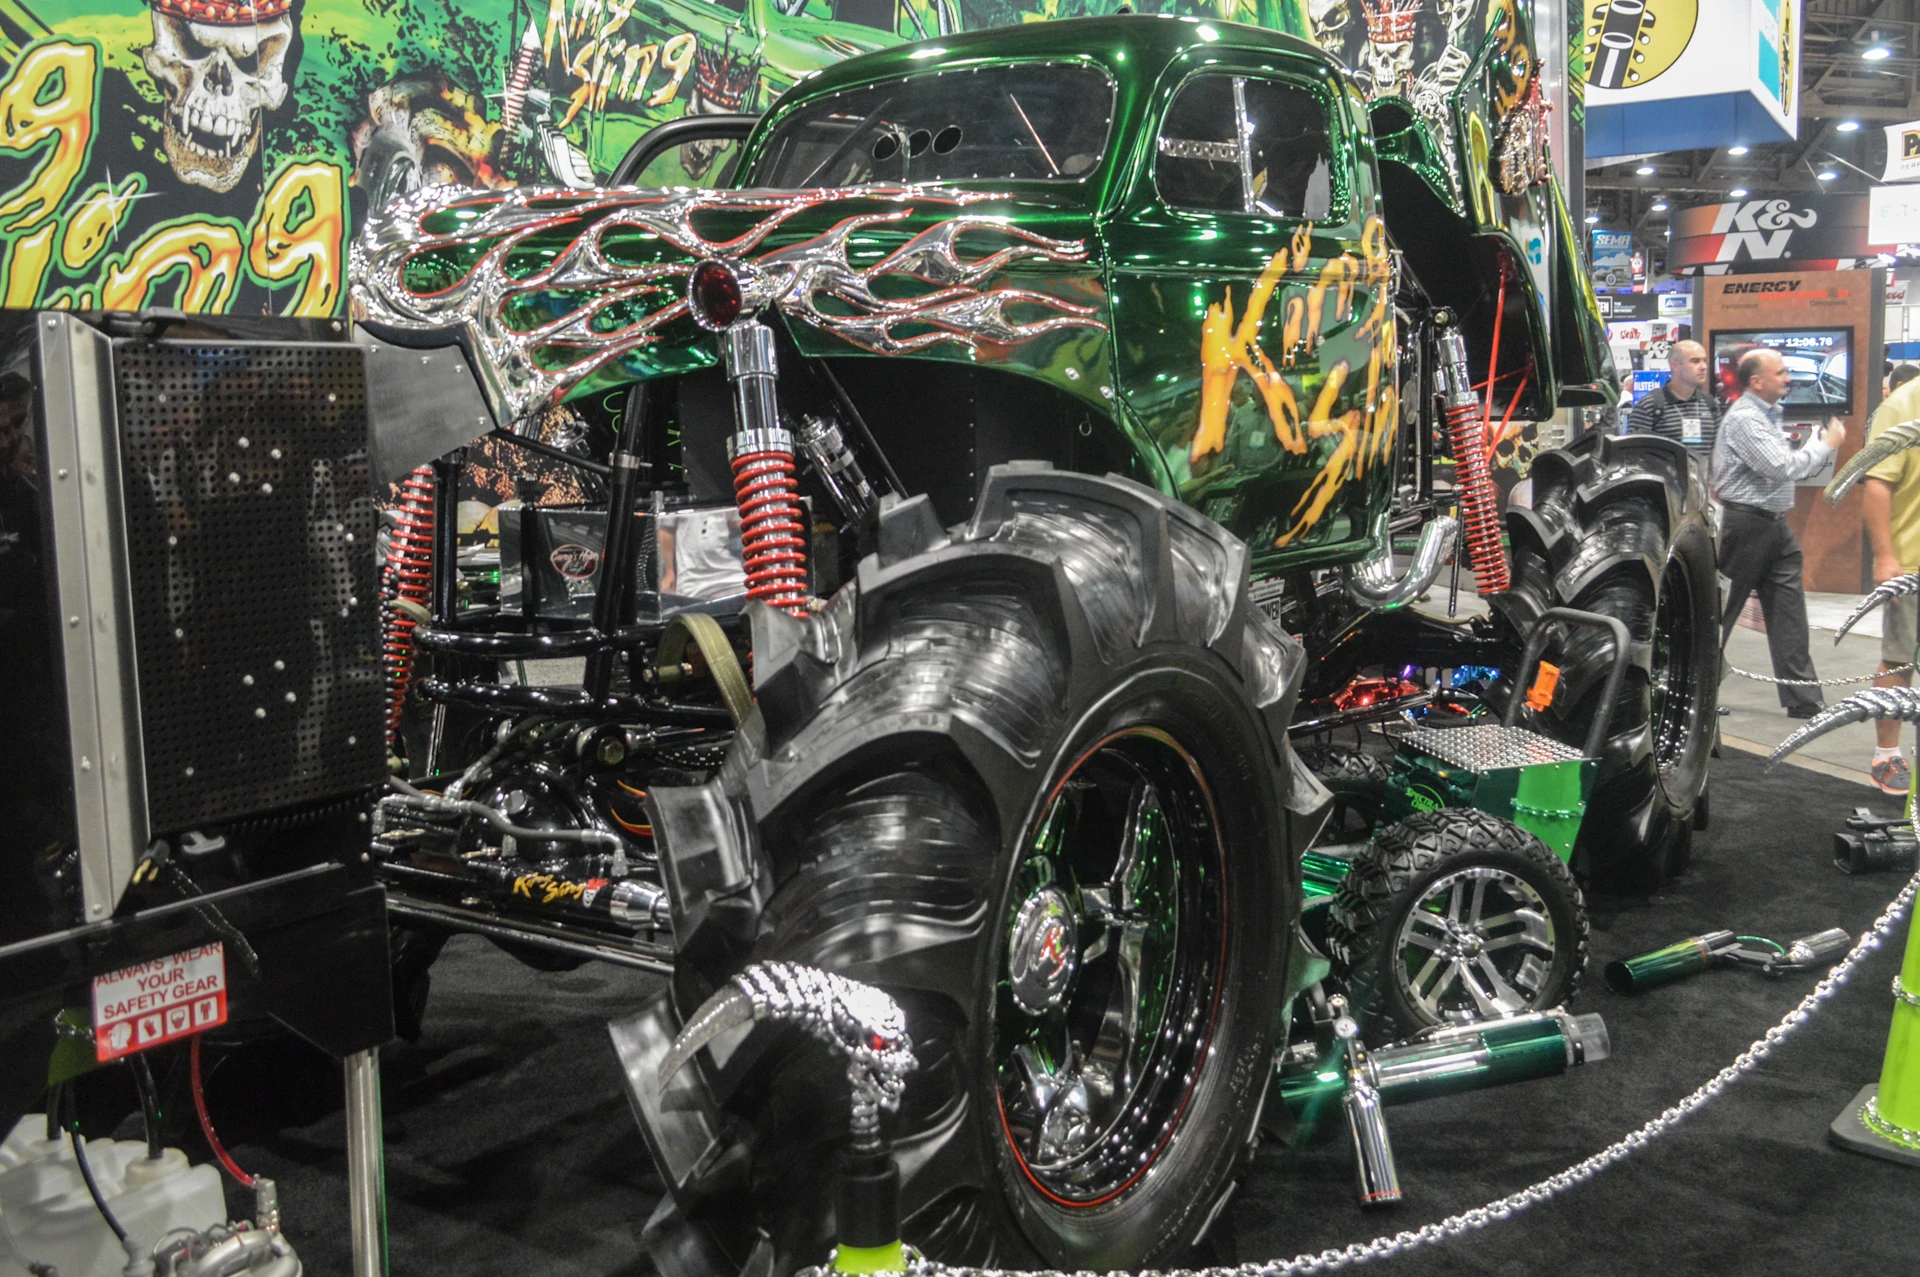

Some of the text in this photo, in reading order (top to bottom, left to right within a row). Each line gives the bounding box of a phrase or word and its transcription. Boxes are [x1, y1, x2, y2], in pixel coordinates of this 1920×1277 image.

[558, 32, 697, 129] Sling
[1596, 234, 1631, 245] SEMA
[1722, 280, 1802, 294] ENERGY
[1405, 787, 1439, 811] SPECTRA
[513, 871, 554, 898] King
[541, 880, 587, 904] Sling
[96, 942, 221, 986] ALWAYS WEAR
[137, 967, 184, 992] YOUR
[103, 974, 218, 1020] SAFETY GEAR
